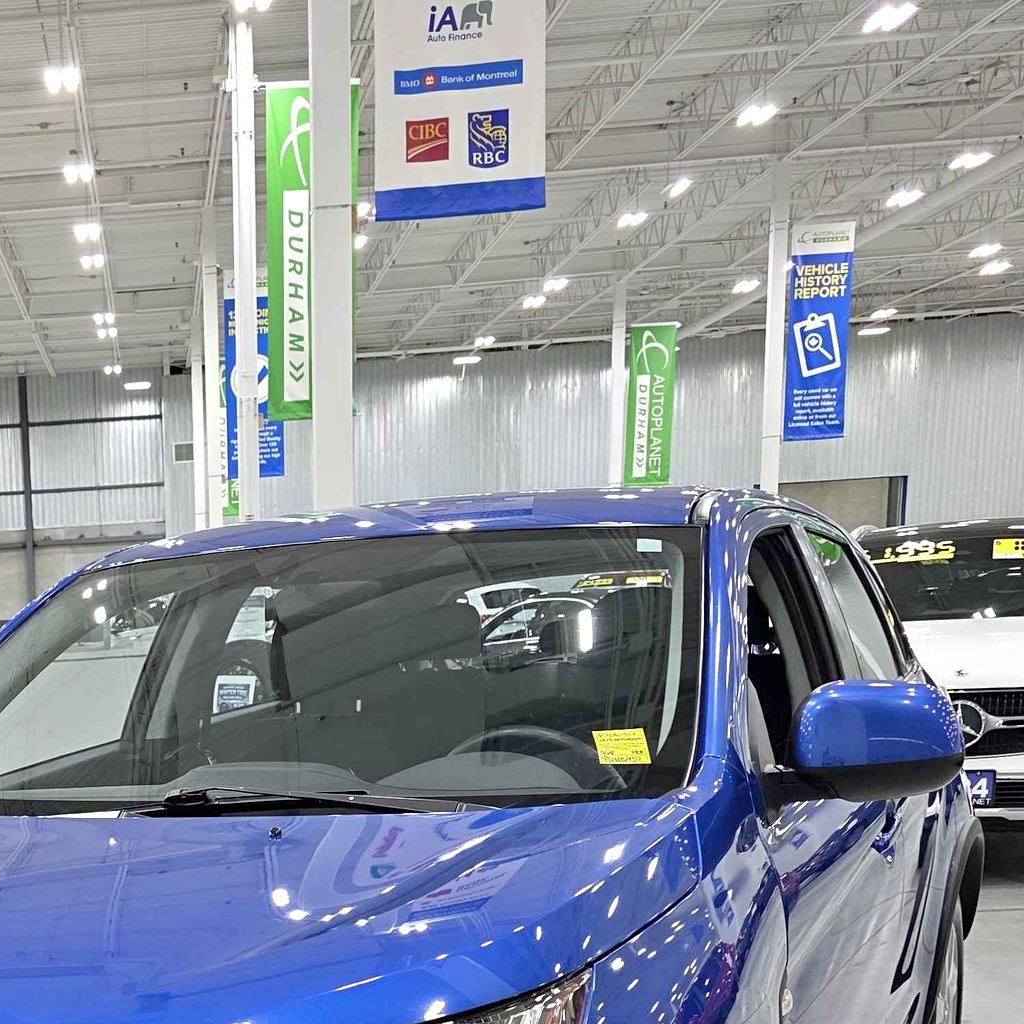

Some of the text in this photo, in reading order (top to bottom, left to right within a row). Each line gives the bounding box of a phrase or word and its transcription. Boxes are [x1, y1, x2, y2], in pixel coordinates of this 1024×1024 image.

[427, 5, 458, 33] iA
[427, 31, 482, 43] Auto Finance
[400, 69, 517, 88] BMO Bank of Montreal
[408, 122, 447, 141] CIBC
[472, 150, 505, 165] RBC
[796, 262, 849, 276] VEHICLE
[288, 210, 305, 352] DURHAM
[794, 274, 848, 288] HISTORY
[794, 285, 847, 300] REPORT
[636, 384, 648, 453] DURHAM
[648, 374, 666, 476] AUTOPLANET
